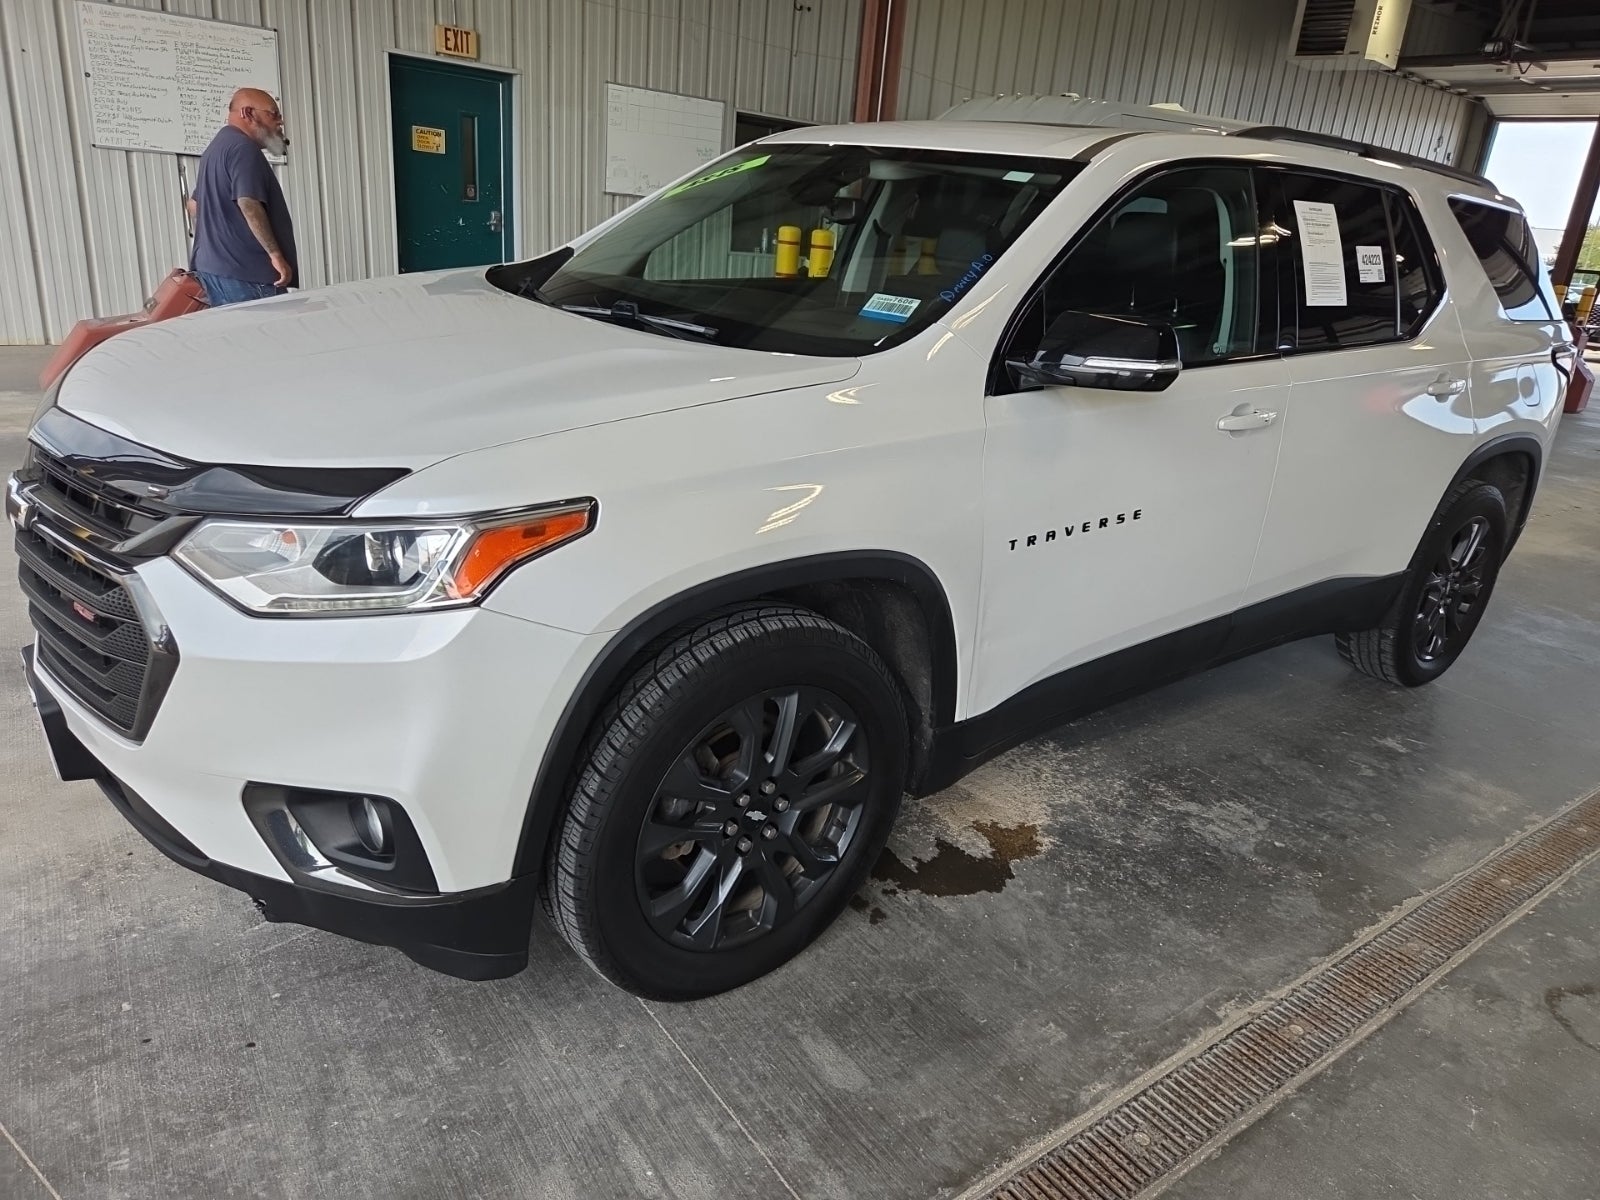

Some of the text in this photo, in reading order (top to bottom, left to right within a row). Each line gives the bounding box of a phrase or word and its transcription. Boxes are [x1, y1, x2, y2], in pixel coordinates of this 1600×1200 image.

[1372, 5, 1383, 35] REZNOR
[444, 27, 471, 54] EXIT
[416, 129, 441, 137] CAUTION
[1362, 254, 1381, 266] 424223
[1008, 509, 1142, 551] TRAVERSE
